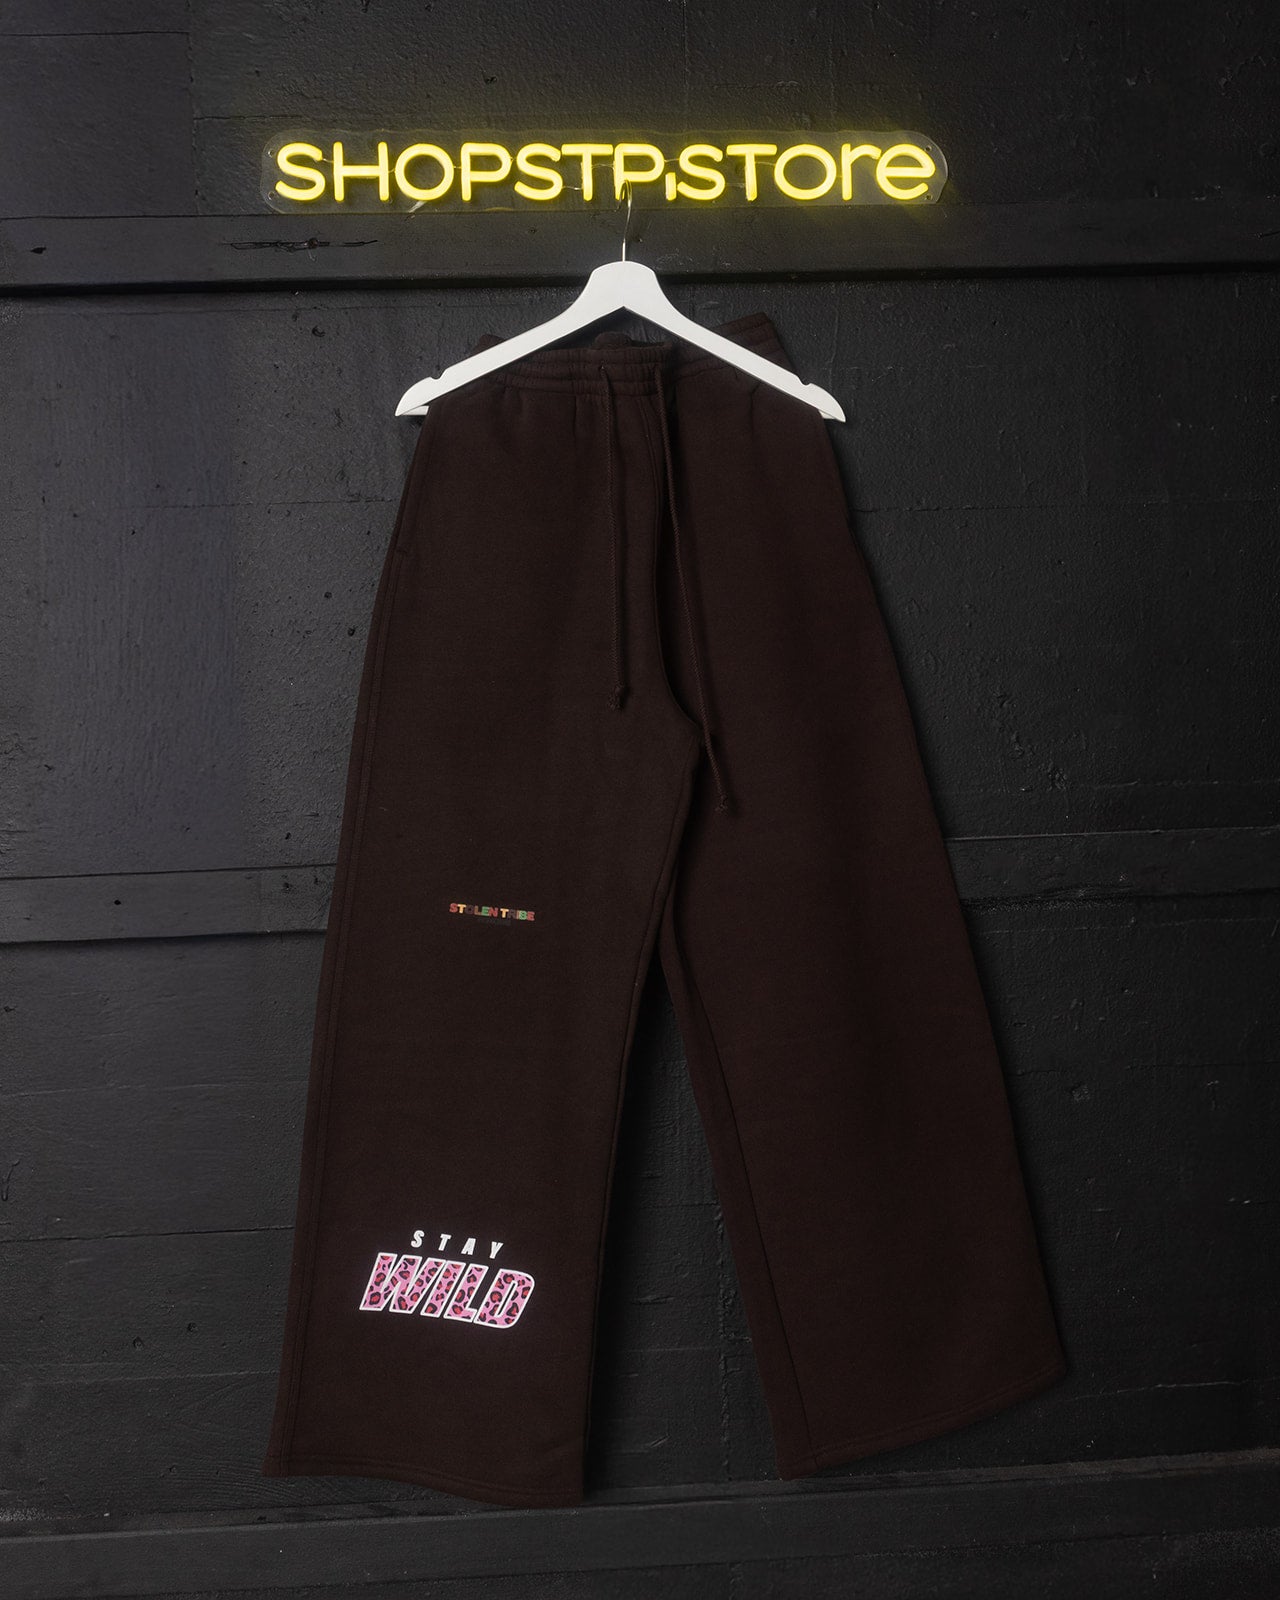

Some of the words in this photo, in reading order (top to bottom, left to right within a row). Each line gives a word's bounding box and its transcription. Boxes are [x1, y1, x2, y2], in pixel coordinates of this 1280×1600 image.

[449, 902, 499, 918] STOLEN
[500, 908, 535, 921] TRIBE
[410, 1230, 504, 1260] STAY
[359, 1251, 536, 1329] WILD
